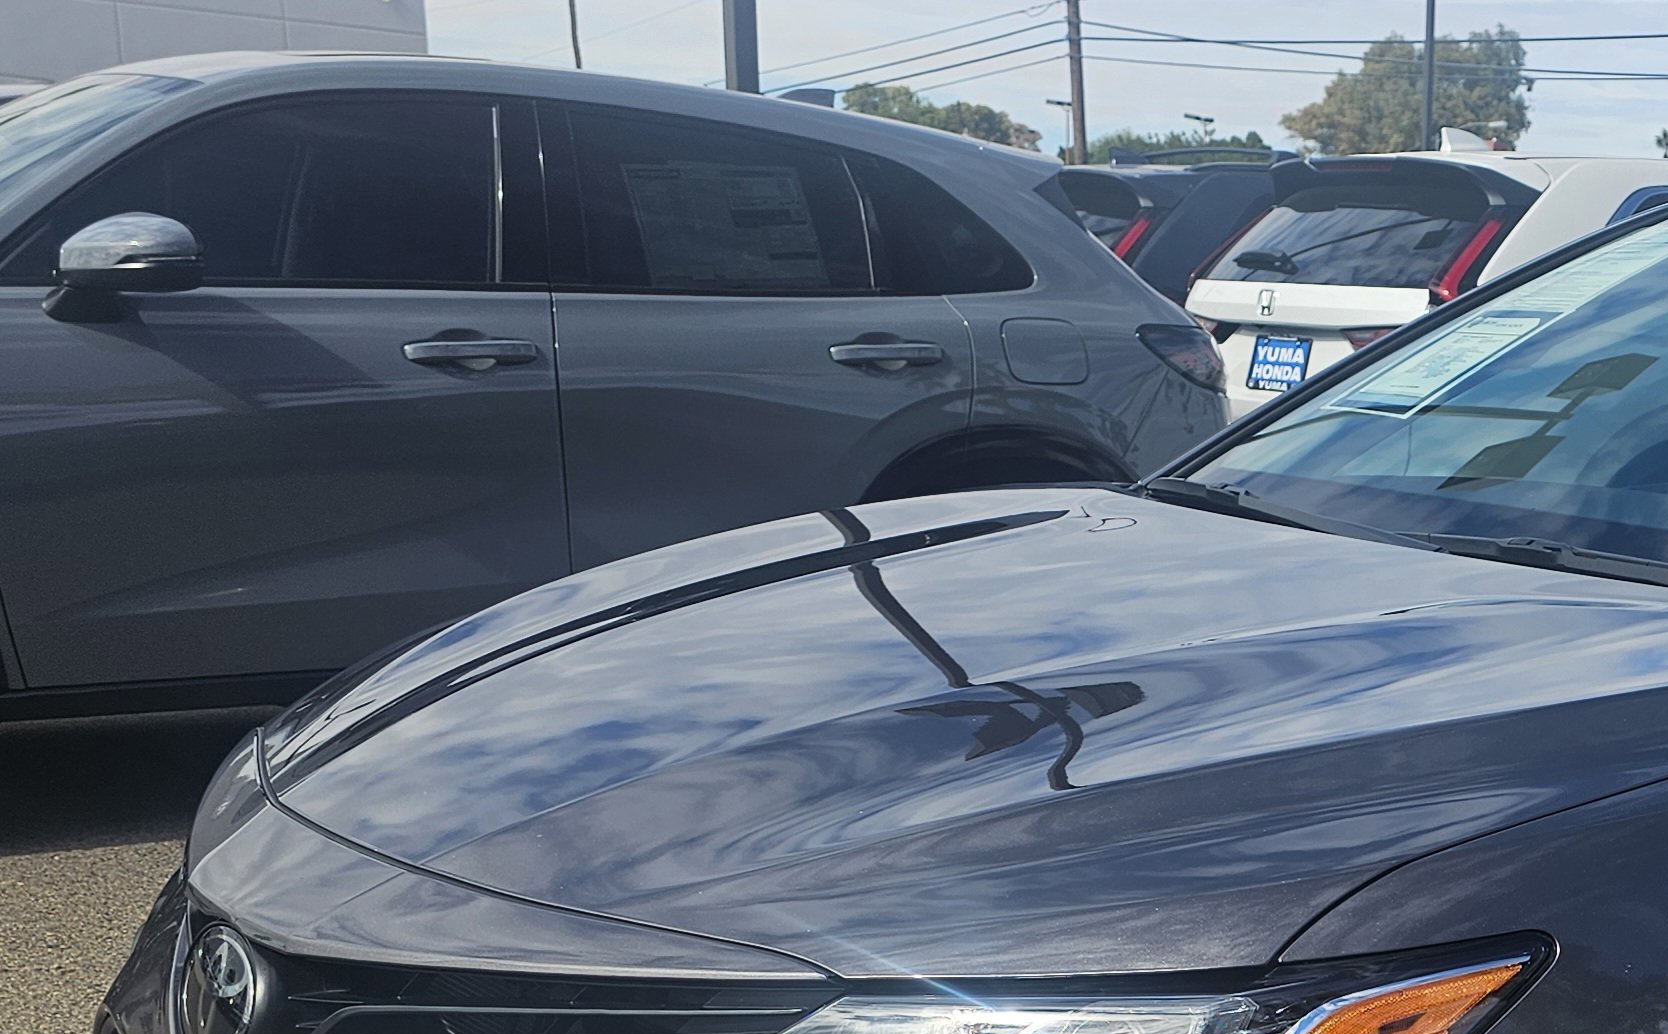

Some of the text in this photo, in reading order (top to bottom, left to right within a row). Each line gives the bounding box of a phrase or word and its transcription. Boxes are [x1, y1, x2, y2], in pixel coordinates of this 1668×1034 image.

[1256, 345, 1305, 364] YUMA
[1251, 363, 1302, 382] HONDA
[1258, 379, 1288, 391] YUMA
